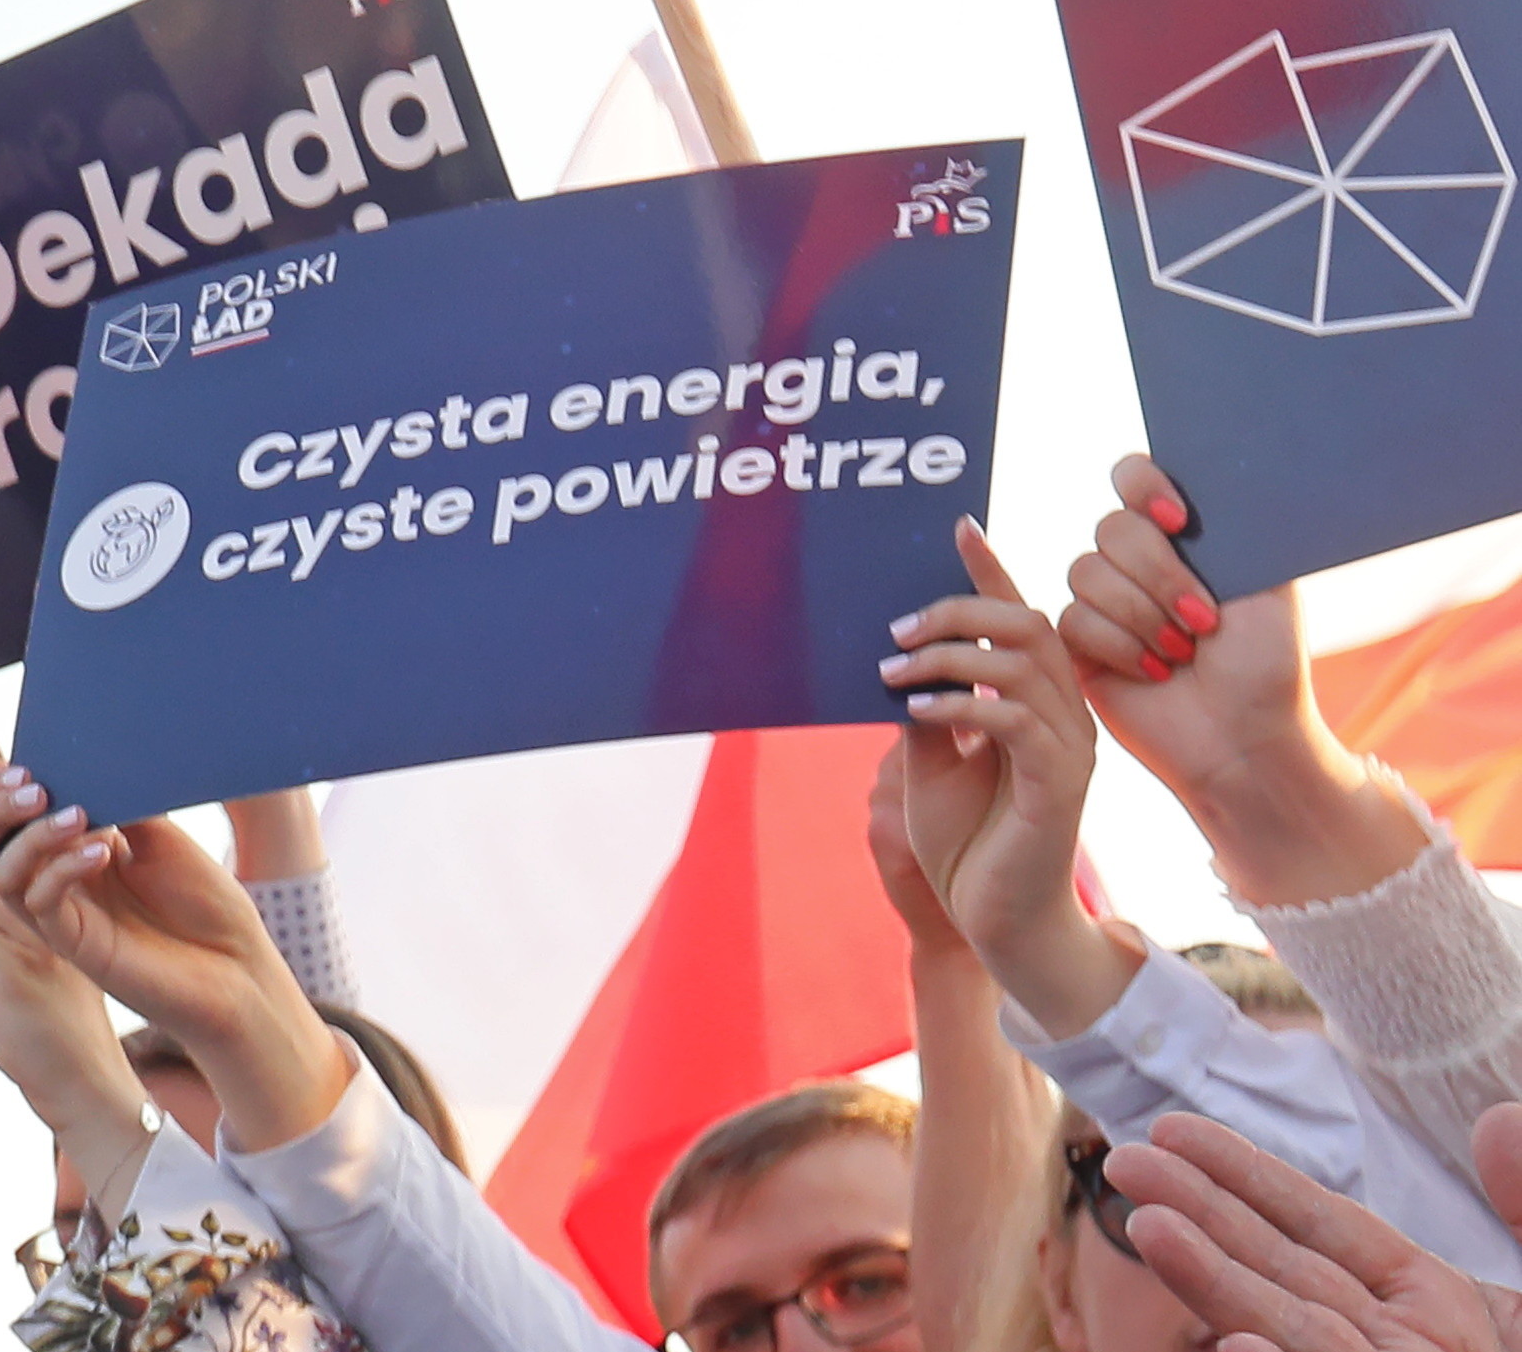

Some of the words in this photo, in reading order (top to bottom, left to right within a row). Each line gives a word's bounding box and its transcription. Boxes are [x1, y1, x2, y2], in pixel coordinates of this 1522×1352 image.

[198, 250, 338, 315] POLSKI
[237, 392, 530, 490] Czysta
[548, 336, 946, 426] energia,
[201, 484, 475, 582] czyste
[491, 433, 967, 545] powietrze
